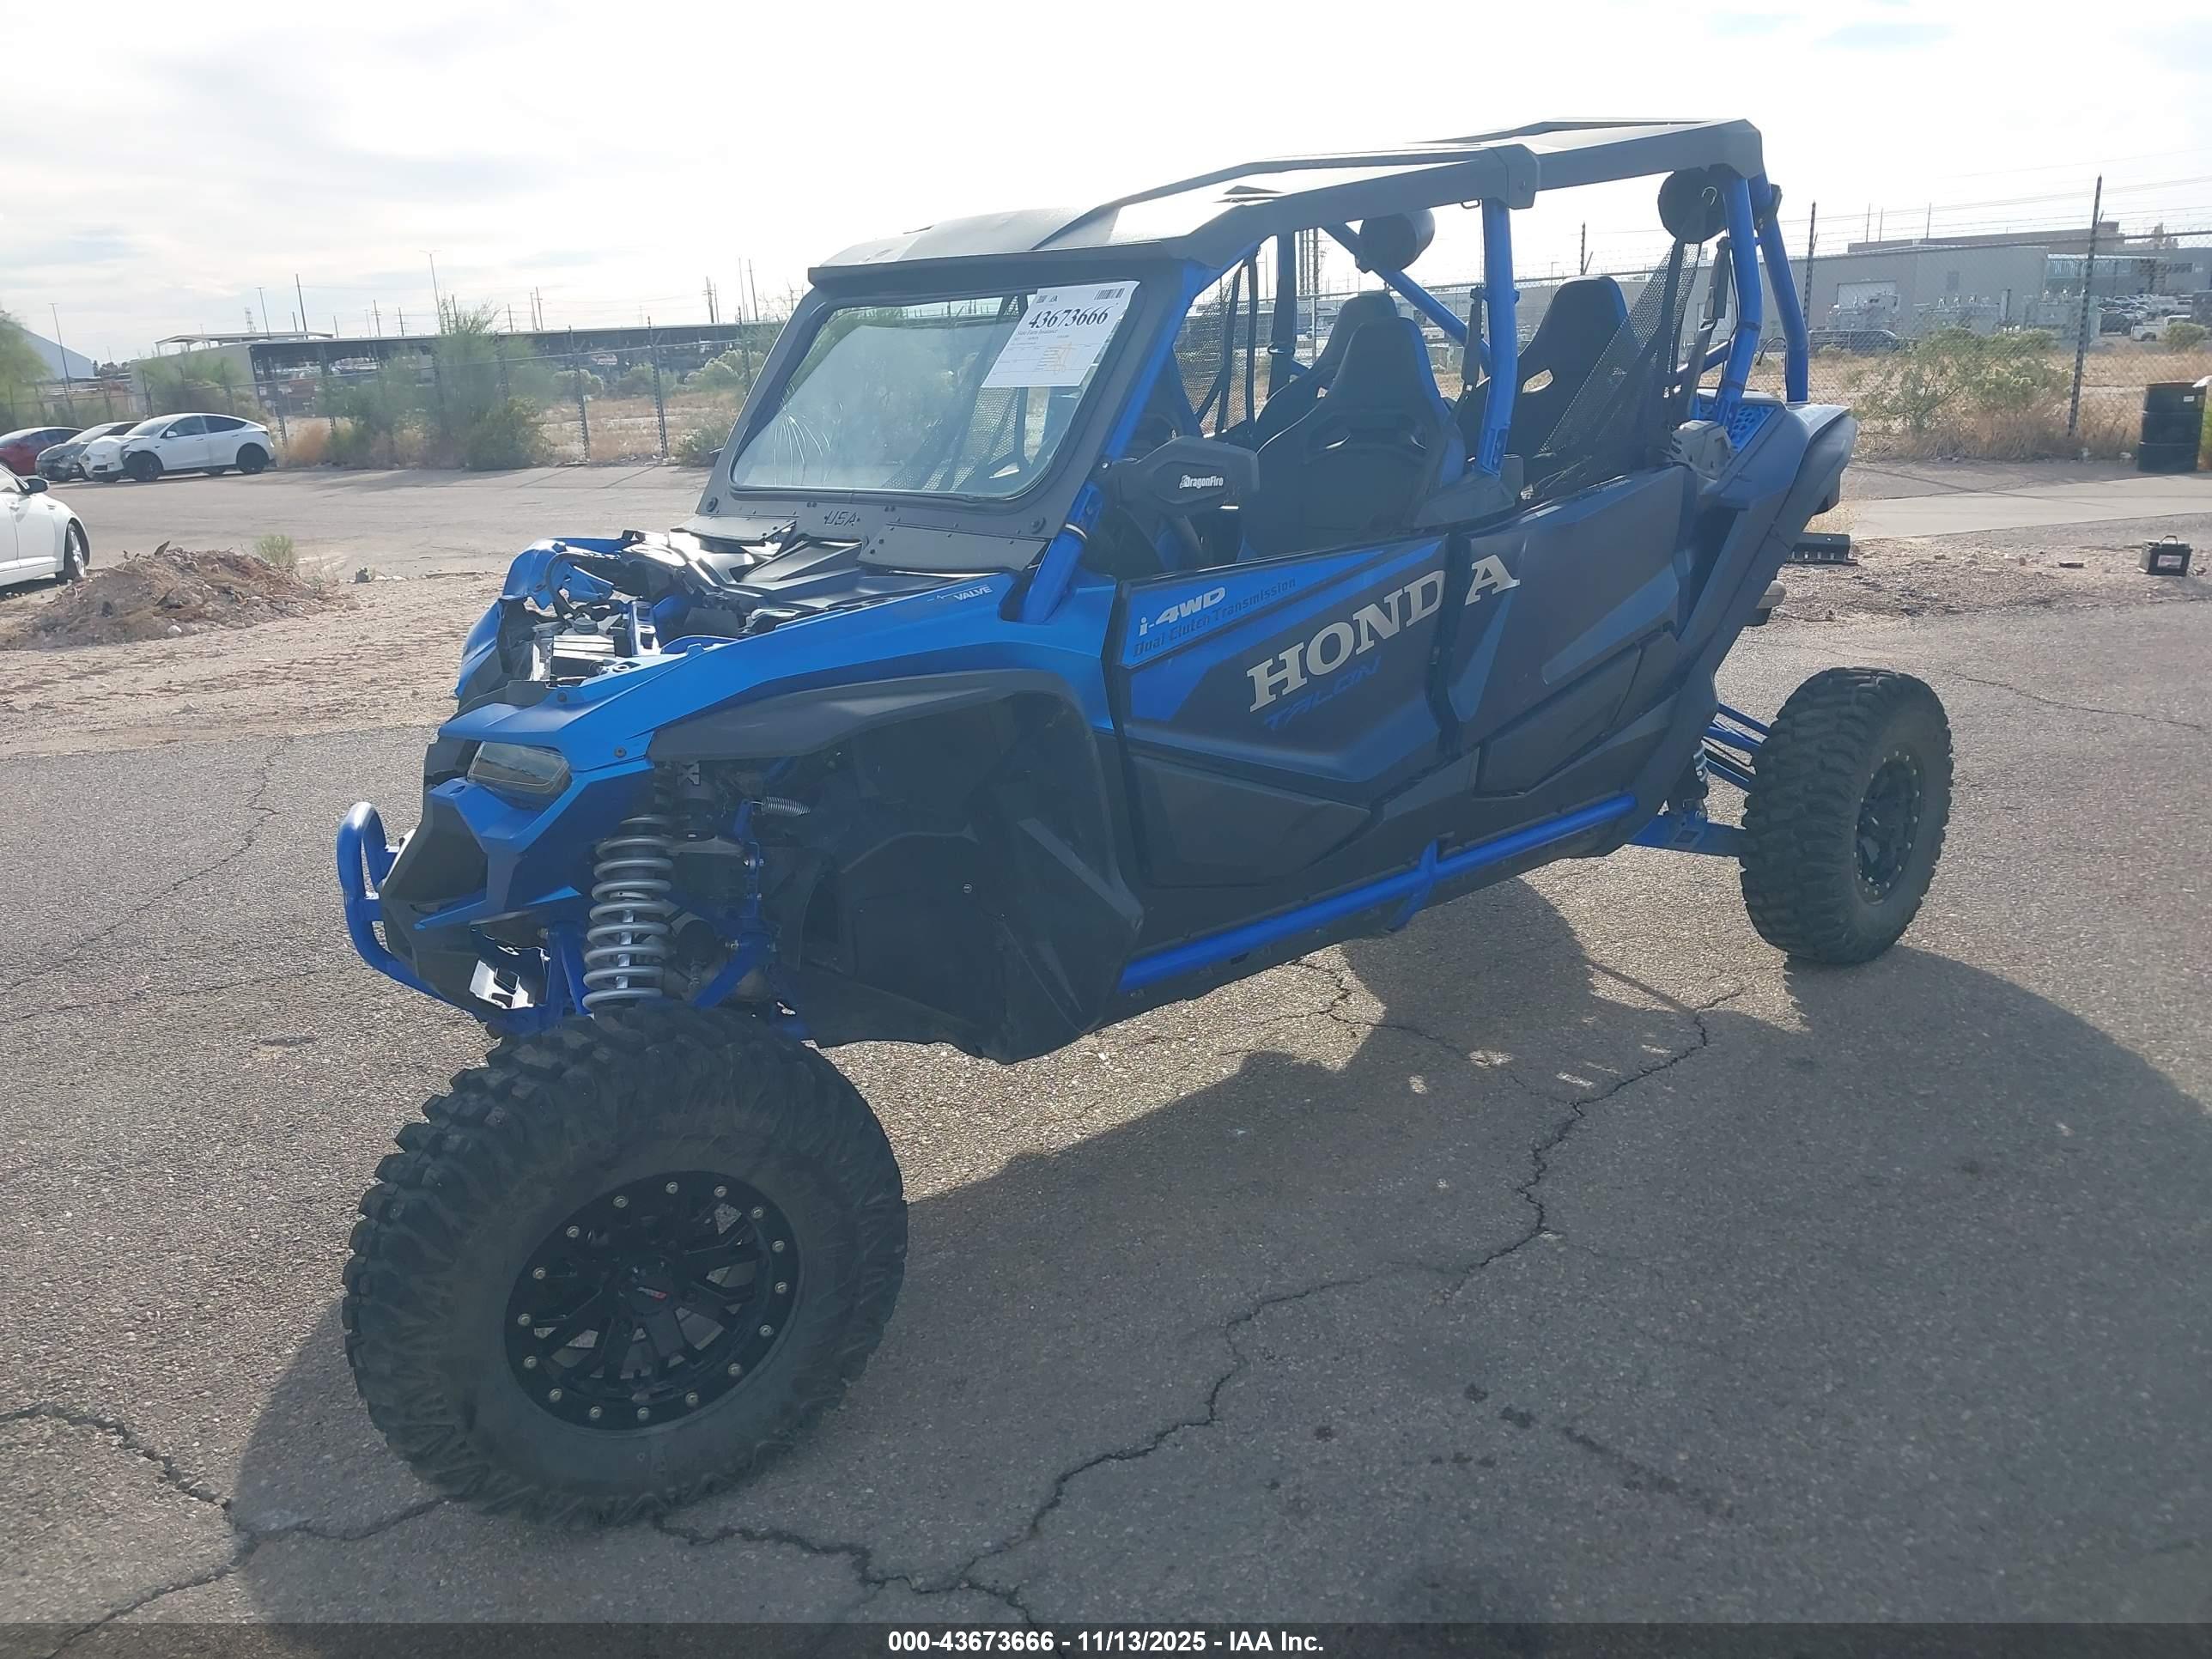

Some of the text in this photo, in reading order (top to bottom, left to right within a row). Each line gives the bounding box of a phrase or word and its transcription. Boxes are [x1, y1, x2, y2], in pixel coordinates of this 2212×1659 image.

[1029, 305, 1115, 329] 43673666
[1179, 474, 1224, 489] DragonFire
[953, 586, 993, 601] VALVE
[1139, 586, 1227, 637] i-4WD
[1133, 577, 1297, 657] Dual Clutch Transmission
[1246, 554, 1521, 712] HONDA
